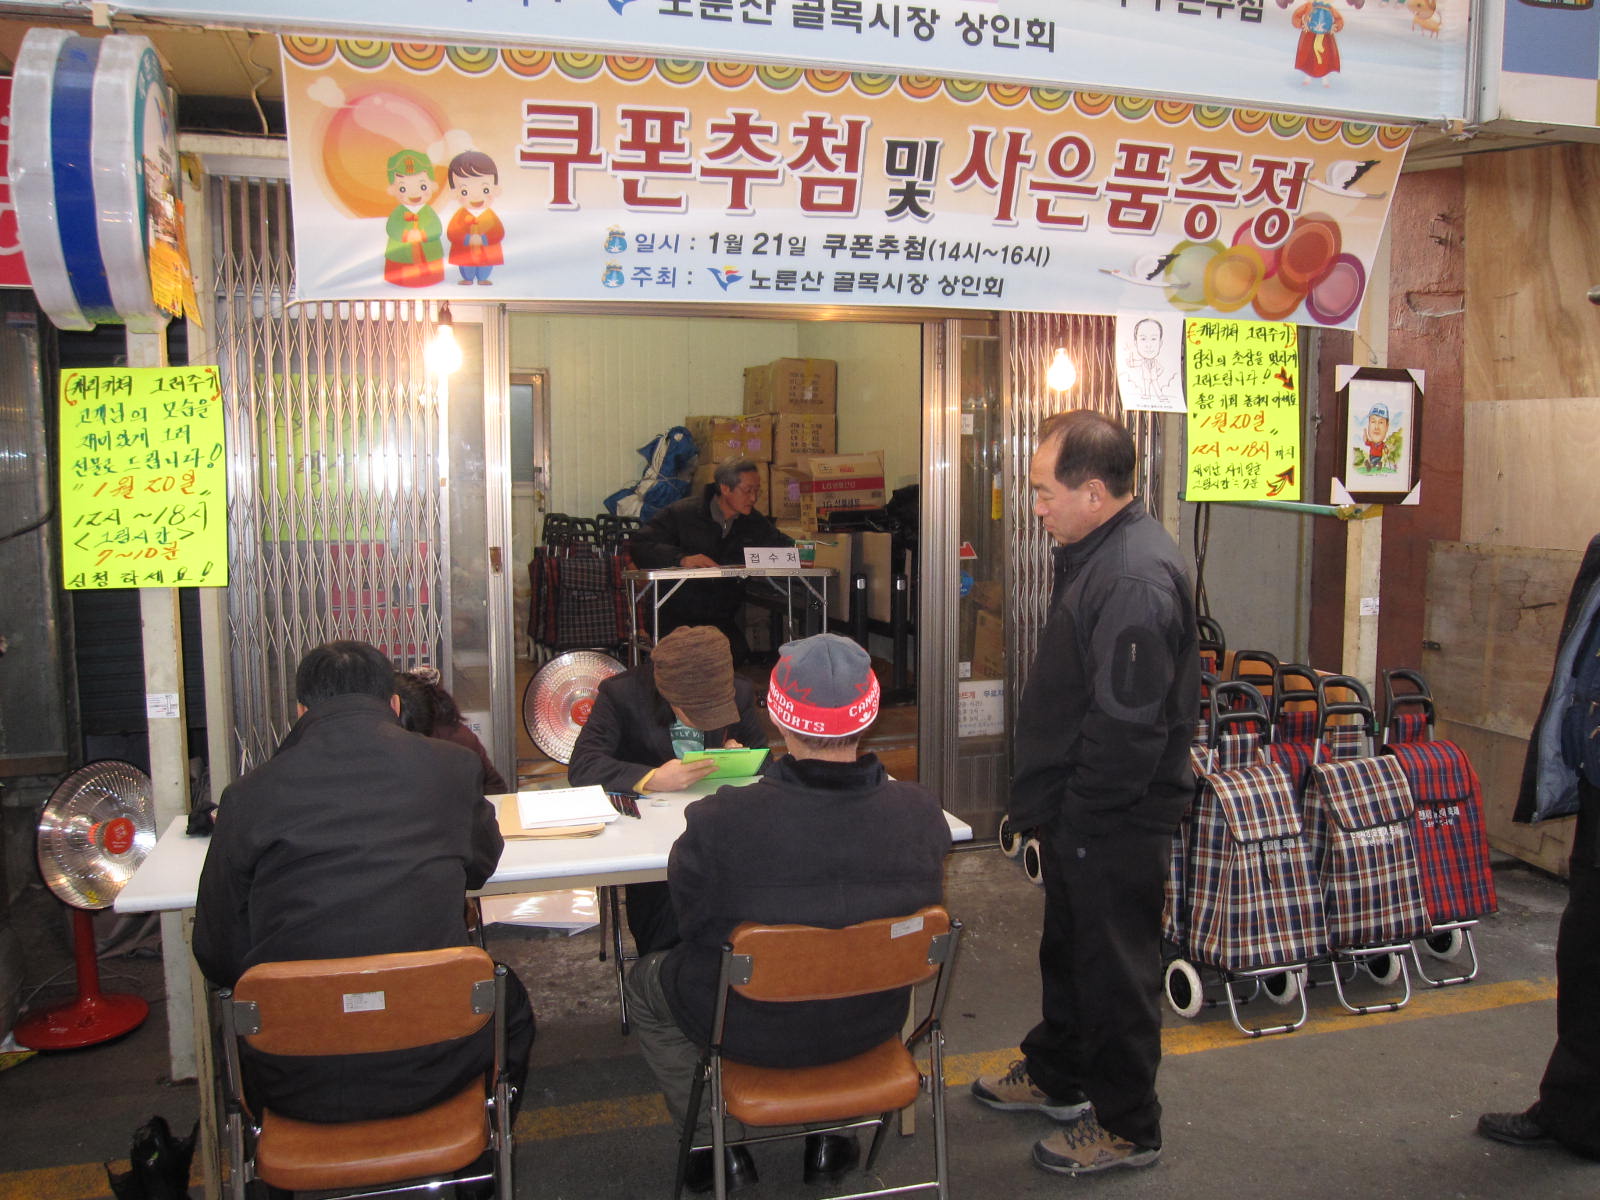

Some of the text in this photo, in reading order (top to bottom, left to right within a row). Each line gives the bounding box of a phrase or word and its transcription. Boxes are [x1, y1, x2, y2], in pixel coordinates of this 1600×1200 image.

[792, 0, 940, 42] 골목시장
[954, 12, 1055, 53] 상인회
[517, 102, 1311, 246] 쿠폰추첨 및 사은품증정
[634, 232, 680, 254] 일시
[709, 231, 744, 255] 1월
[751, 232, 807, 257] 21일
[822, 232, 1051, 267] 쿠폰추첨(14시~16시)
[630, 265, 677, 288] 주최
[749, 268, 825, 292] 노룬산
[833, 271, 929, 295] 골목시장
[937, 274, 1005, 298] 상인회
[1193, 348, 1227, 370] 당신의
[1232, 348, 1264, 367] 초상을
[769, 682, 795, 713] NADA
